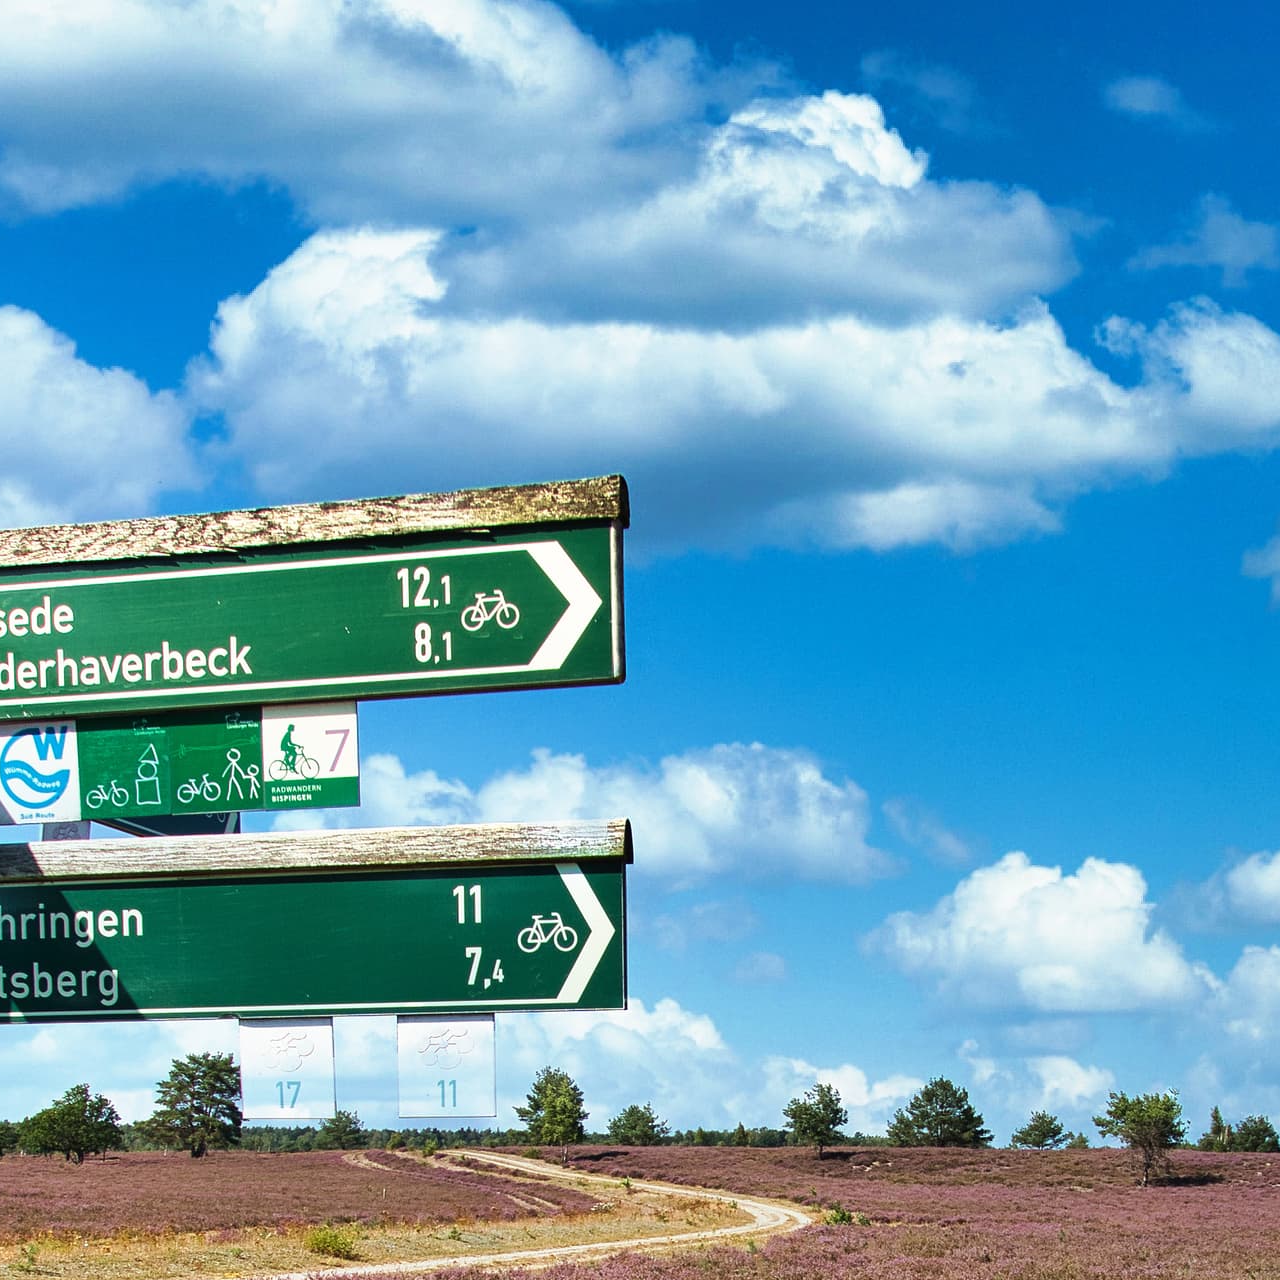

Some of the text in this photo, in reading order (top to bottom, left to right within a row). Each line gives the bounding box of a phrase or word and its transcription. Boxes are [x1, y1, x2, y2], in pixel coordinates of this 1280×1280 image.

[397, 566, 451, 608] 12,1
[415, 622, 452, 664] 8,1
[32, 725, 68, 761] W
[325, 729, 350, 773] 7
[271, 784, 322, 793] RADWANDERN
[271, 793, 313, 803] BISPINGEN
[453, 885, 482, 924] 11
[465, 946, 505, 989] 7,4
[275, 1080, 302, 1109] 17
[437, 1079, 457, 1108] 11
